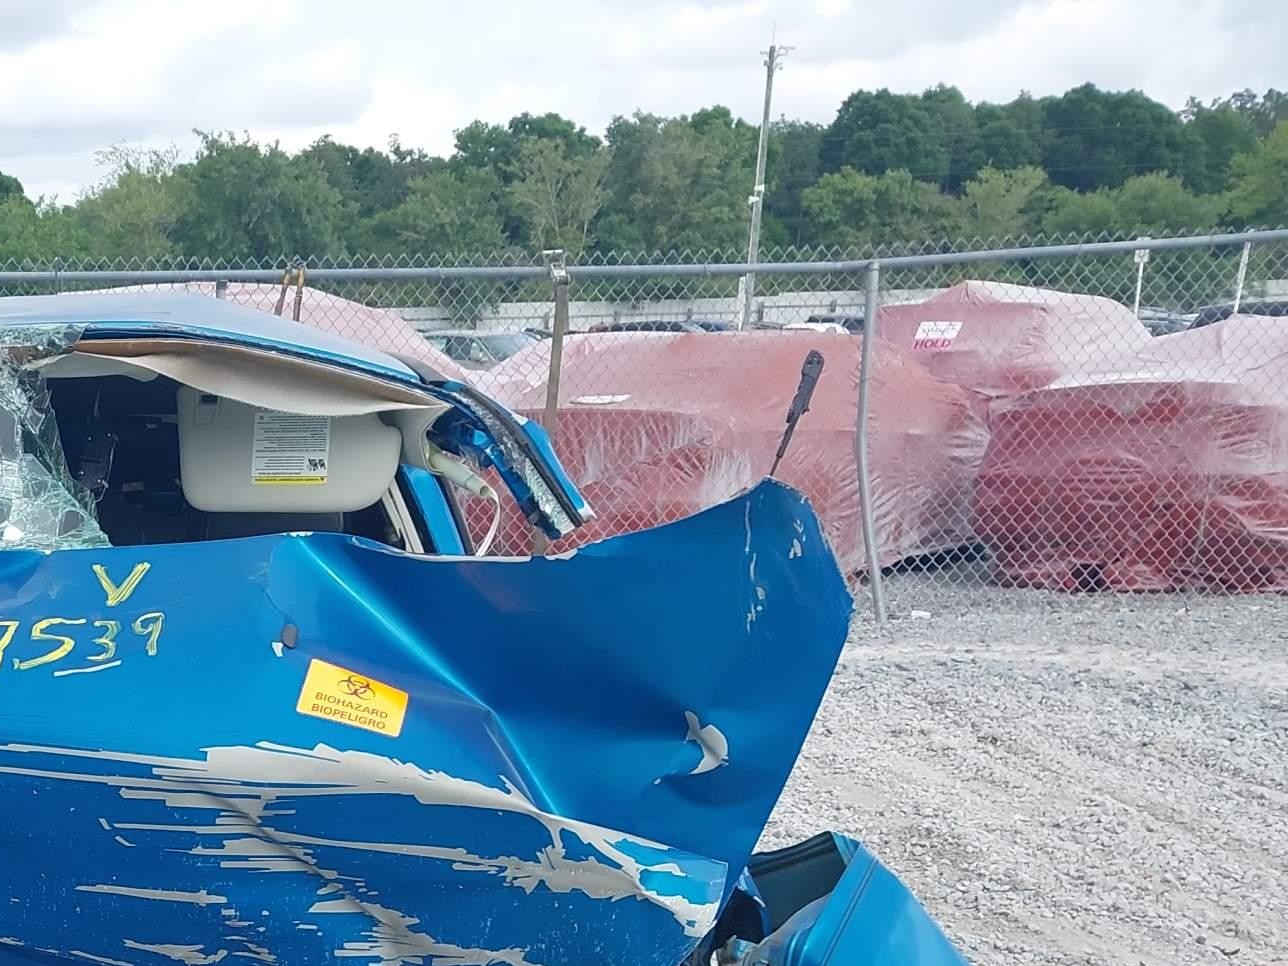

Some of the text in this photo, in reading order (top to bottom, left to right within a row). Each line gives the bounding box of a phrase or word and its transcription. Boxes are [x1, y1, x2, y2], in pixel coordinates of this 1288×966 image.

[913, 339, 951, 350] HOLD
[92, 562, 151, 607] V
[311, 703, 386, 730] BIOPELIGRO
[315, 692, 388, 719] BIOHAZARD
